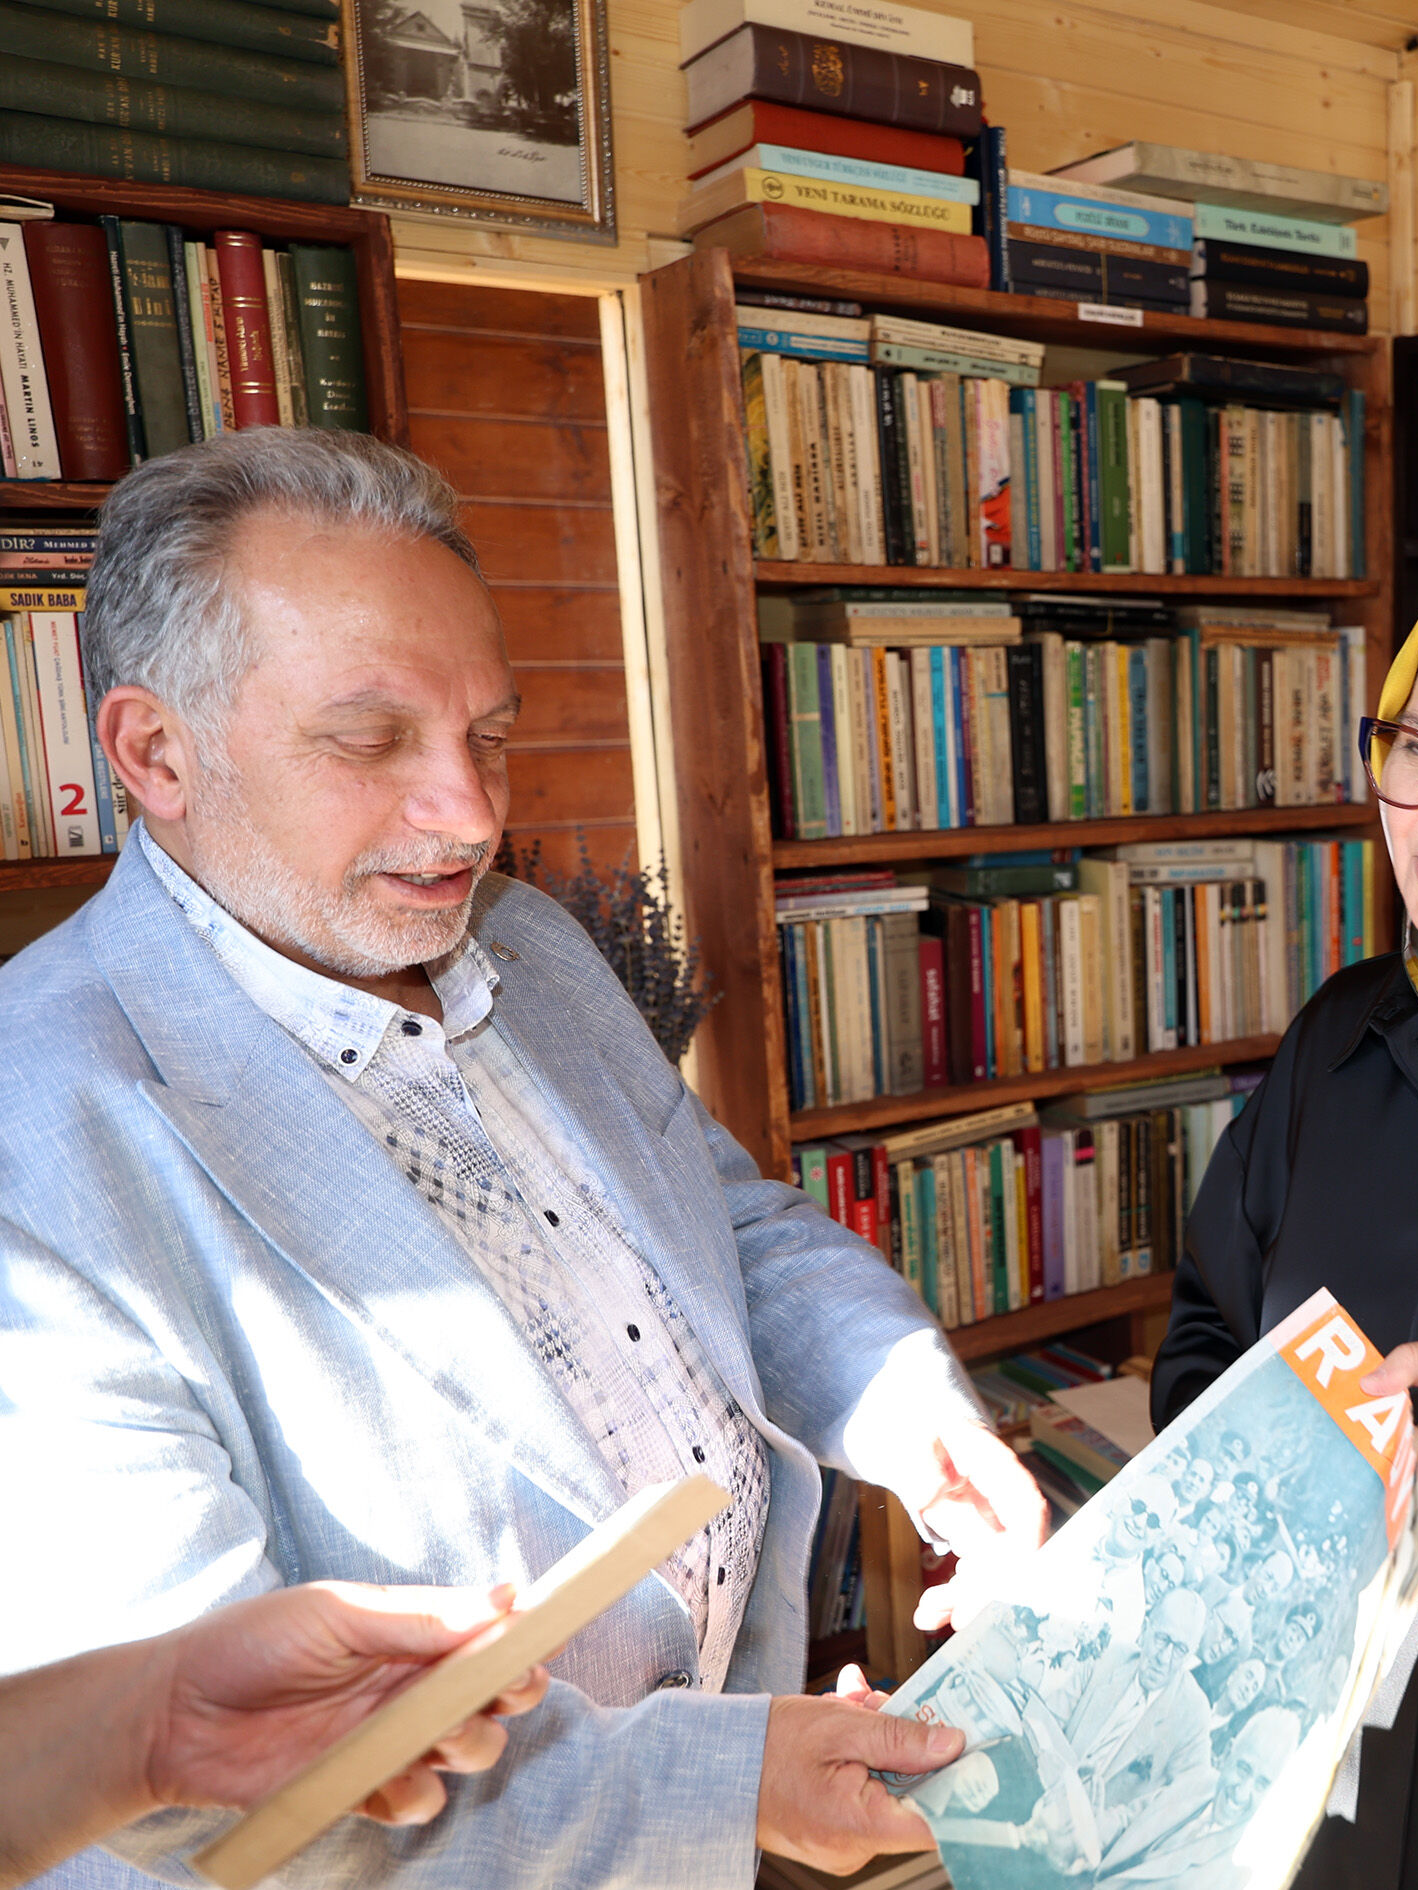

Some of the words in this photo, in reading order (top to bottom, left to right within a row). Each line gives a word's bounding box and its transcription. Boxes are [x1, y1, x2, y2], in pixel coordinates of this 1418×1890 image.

[794, 184, 828, 200] YENİ
[832, 191, 886, 211] TARAMA
[15, 341, 27, 370] HAYATI
[20, 374, 36, 414] MARTIN
[10, 592, 45, 607] SADIK
[48, 593, 77, 607] BABA
[59, 783, 88, 816] 2
